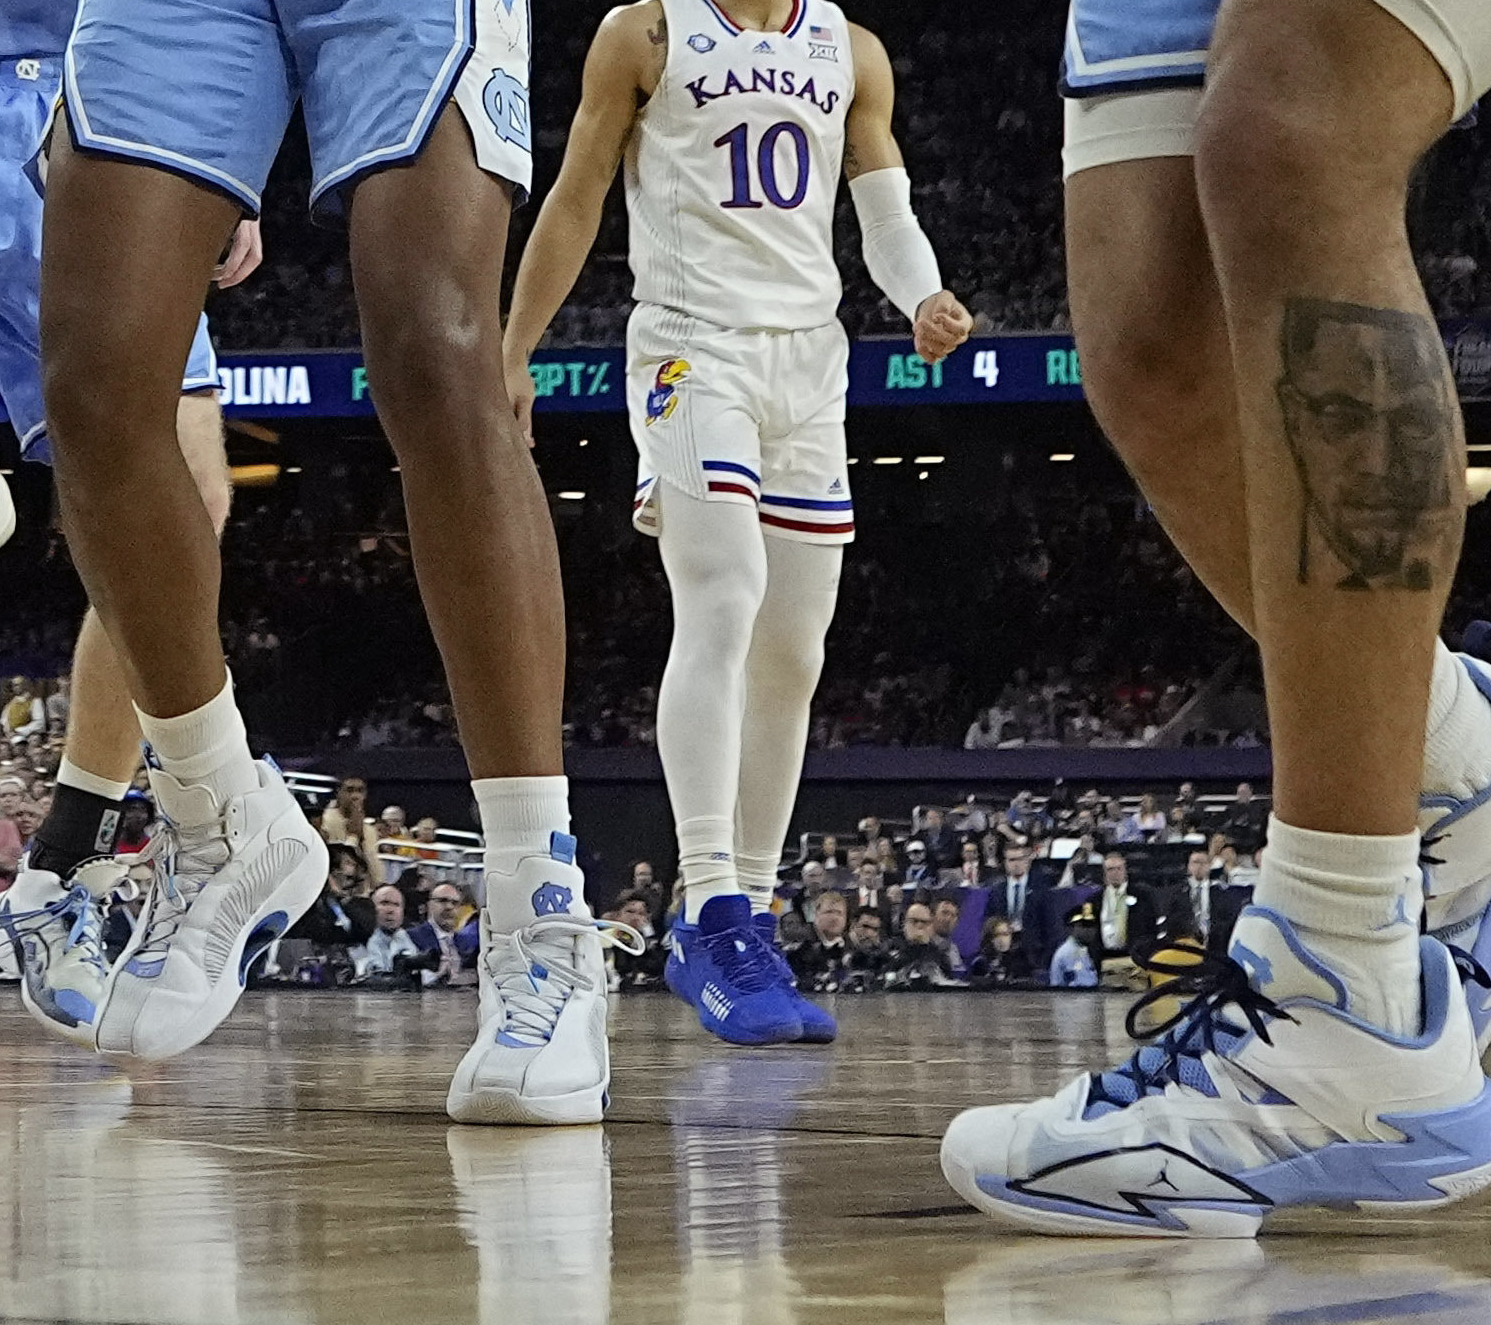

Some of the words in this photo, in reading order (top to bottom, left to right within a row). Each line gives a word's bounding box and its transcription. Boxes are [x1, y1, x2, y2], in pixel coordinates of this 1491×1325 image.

[686, 67, 839, 115] KANSAS
[714, 121, 809, 209] 10
[886, 352, 943, 390] AST
[973, 350, 999, 387] 4
